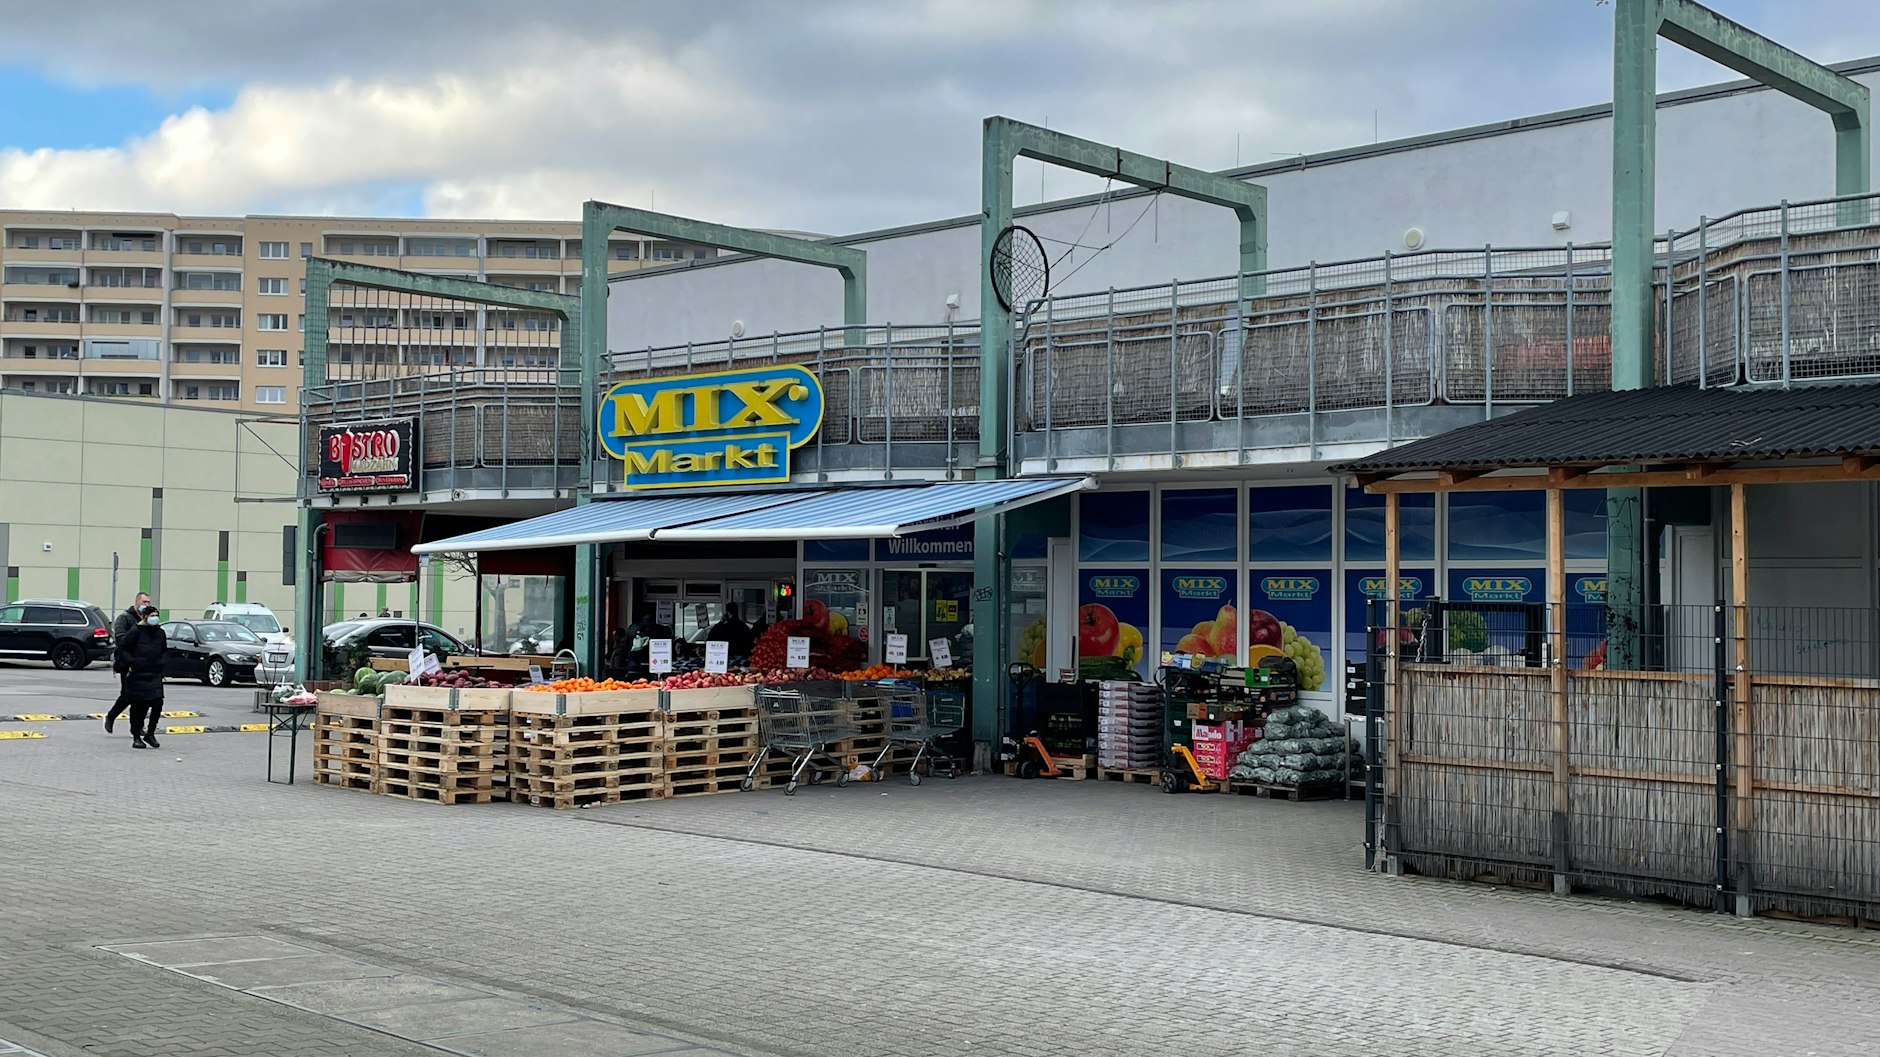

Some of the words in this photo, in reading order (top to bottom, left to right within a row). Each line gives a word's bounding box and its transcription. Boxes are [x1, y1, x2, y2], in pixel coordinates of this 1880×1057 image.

[608, 378, 802, 437] MIX
[625, 443, 779, 474] Markt
[888, 538, 973, 555] Willkommen
[817, 573, 856, 583] MIX
[1095, 579, 1135, 588] MIX
[1178, 579, 1222, 589] MIX
[1267, 580, 1315, 590] MIX
[1365, 580, 1417, 590] MX
[1468, 580, 1526, 591] MIX
[1474, 592, 1520, 600] Markt
